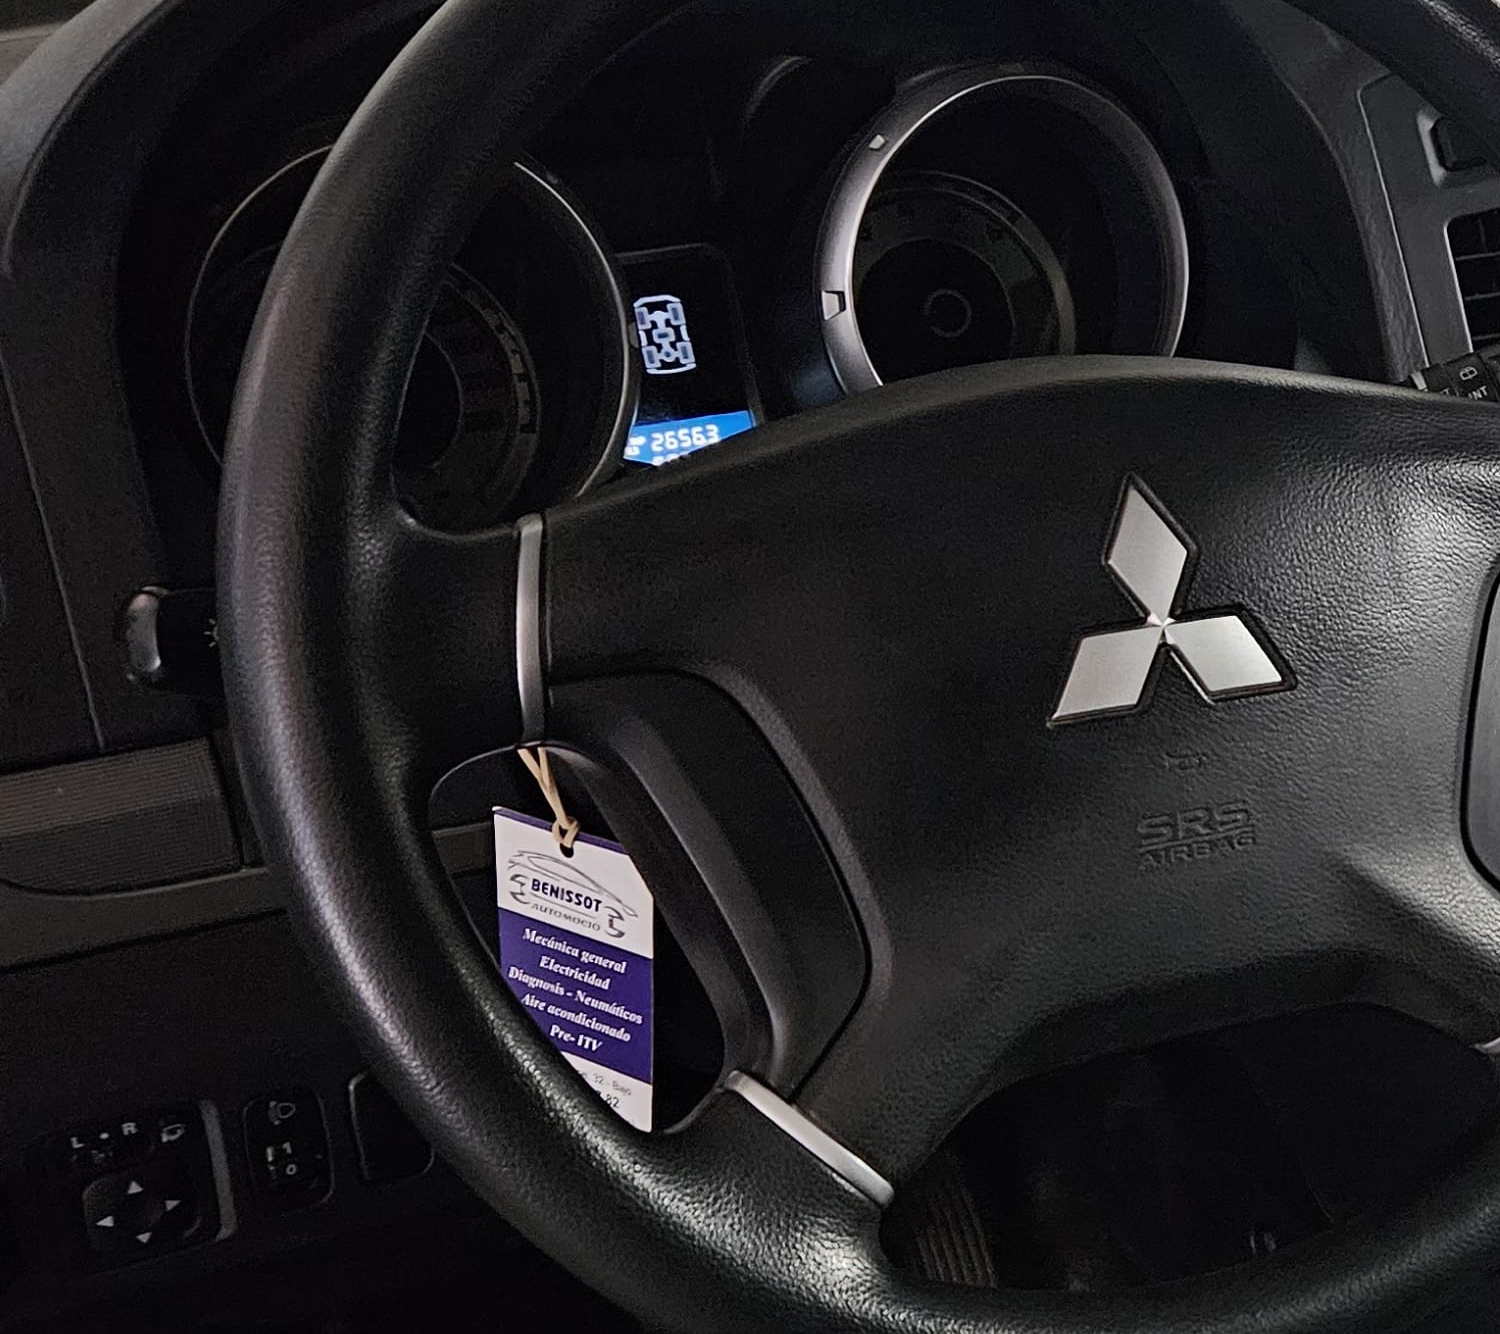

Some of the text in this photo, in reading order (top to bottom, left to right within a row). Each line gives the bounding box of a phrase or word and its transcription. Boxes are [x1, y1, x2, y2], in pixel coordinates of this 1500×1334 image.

[1136, 798, 1250, 846] SRS
[530, 877, 603, 913] BENISSOT
[522, 927, 628, 975] Mecánica general
[538, 955, 612, 990] Electricidad
[508, 966, 566, 997] Diagnosis
[574, 989, 644, 1025] Neumáticos
[521, 993, 632, 1042] Aire acondicionado
[576, 1034, 604, 1052] ITV
[69, 1120, 139, 1149] L R
